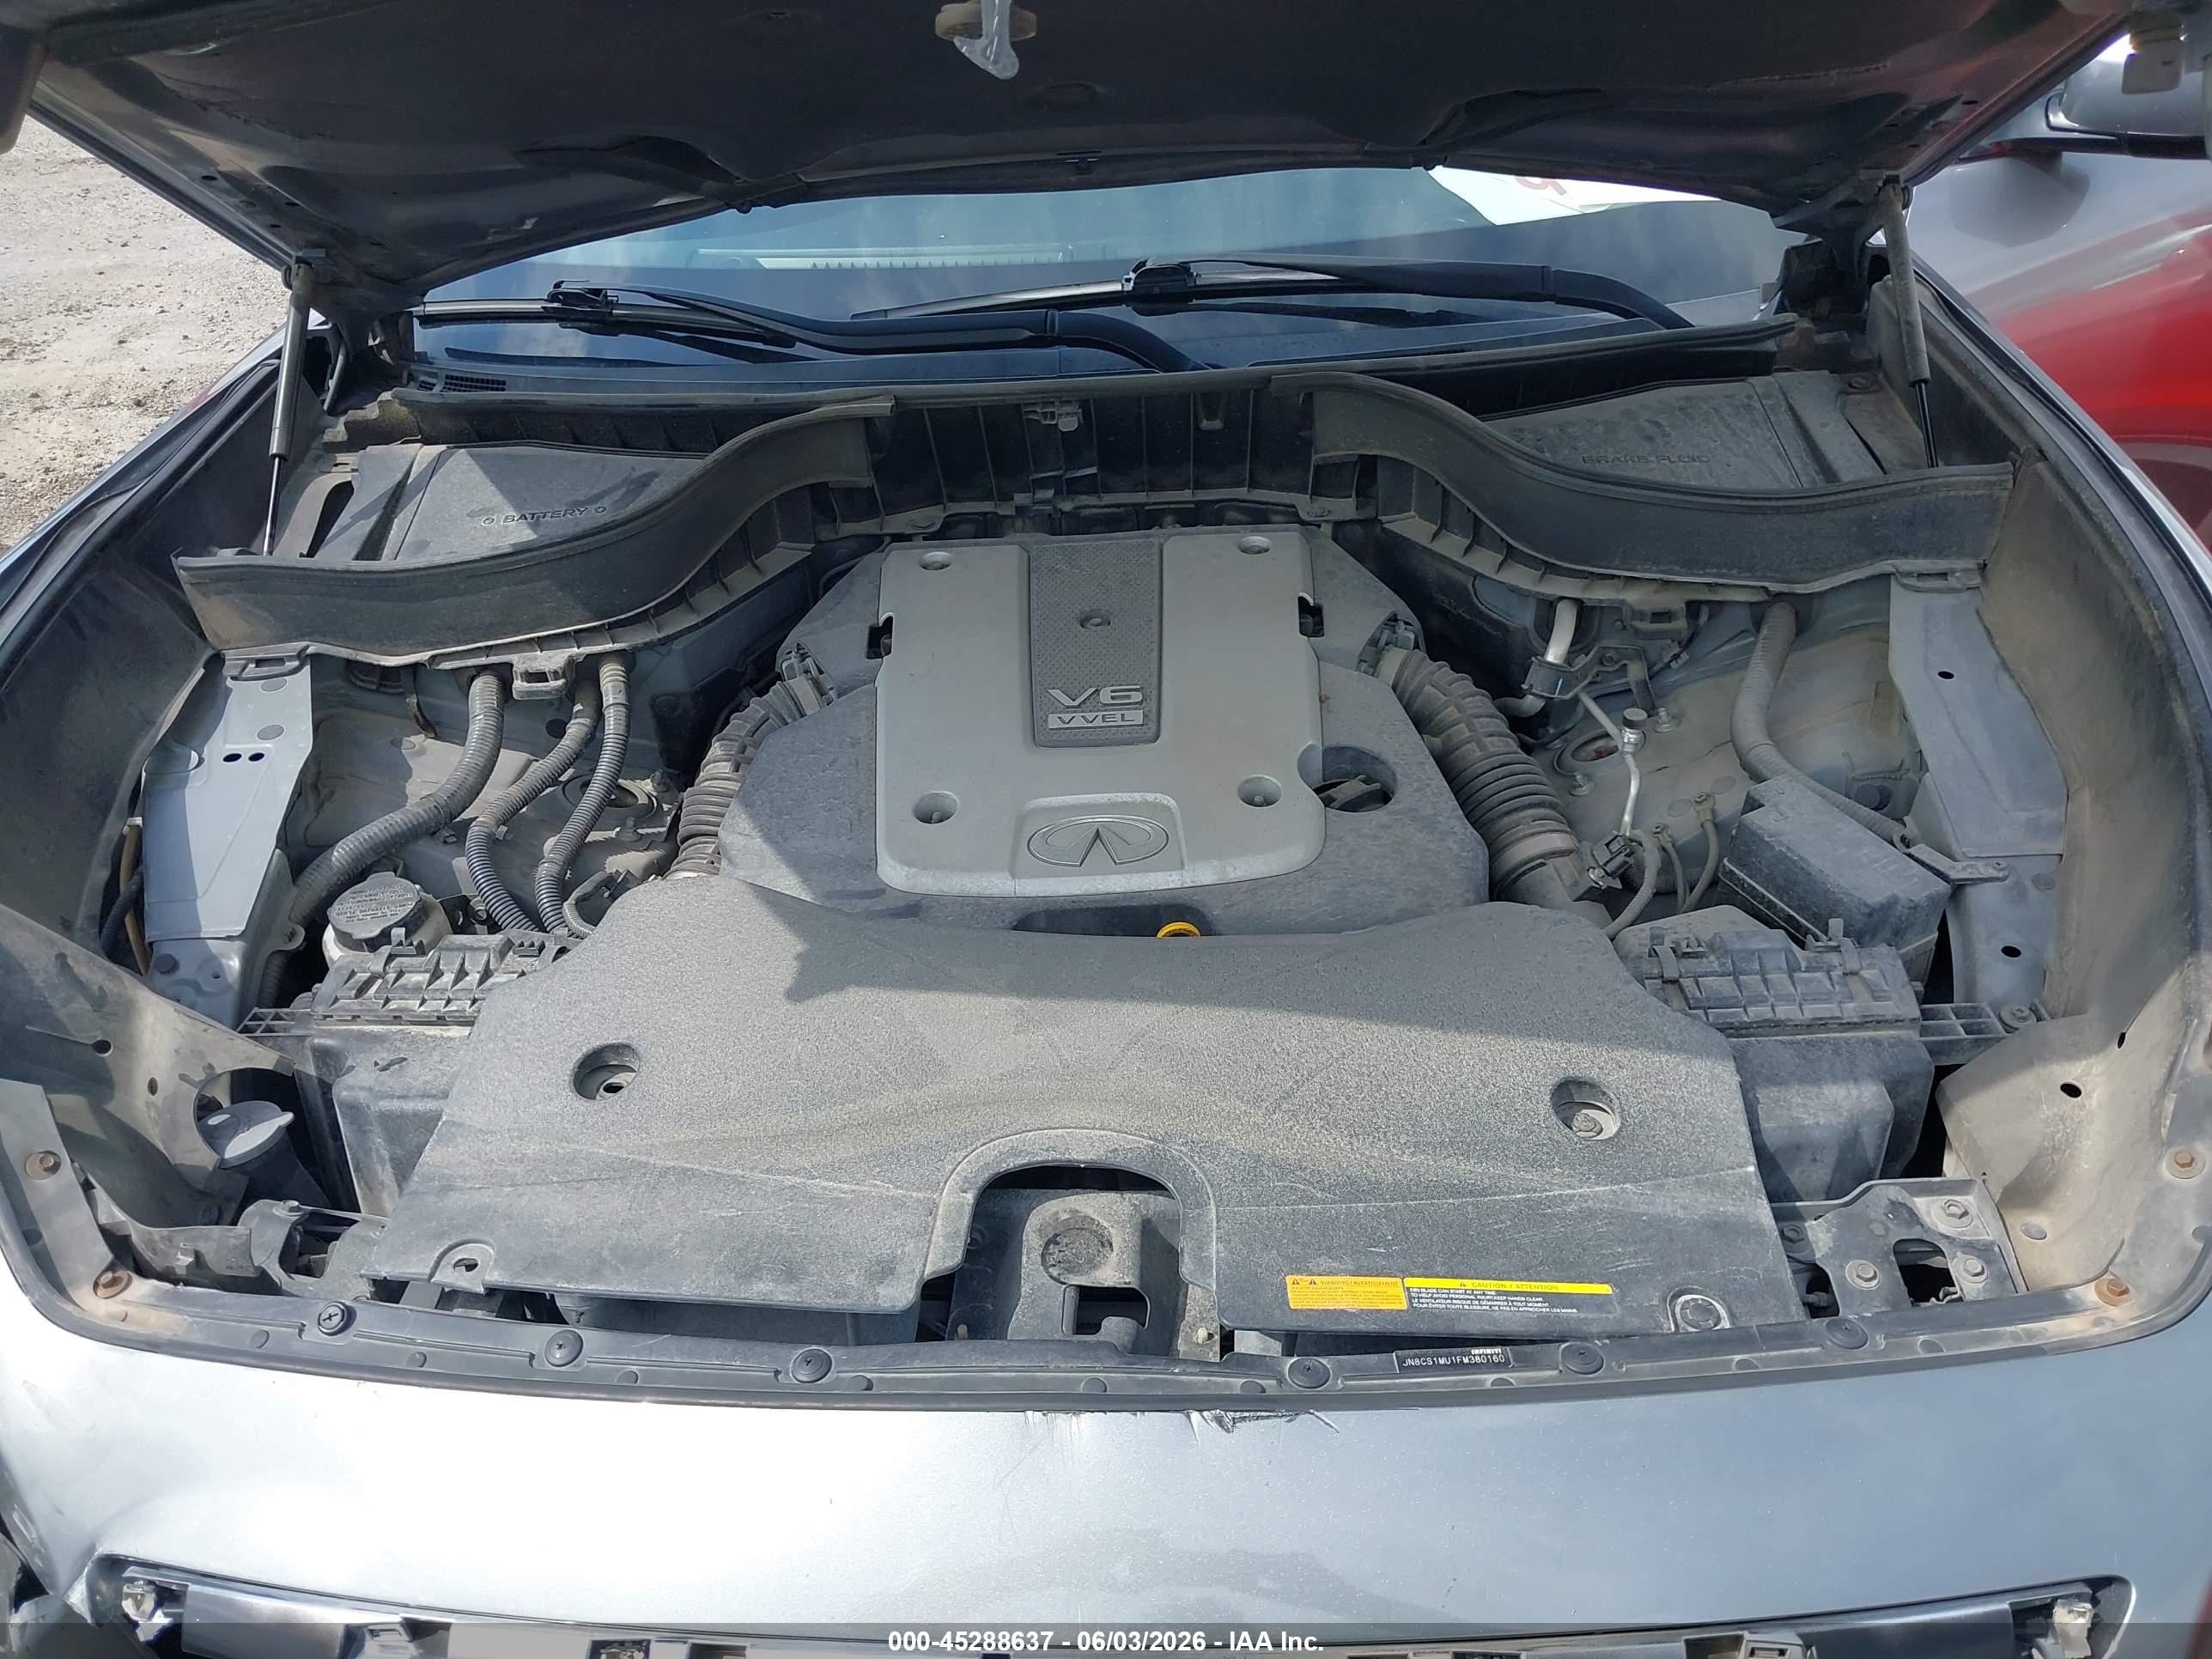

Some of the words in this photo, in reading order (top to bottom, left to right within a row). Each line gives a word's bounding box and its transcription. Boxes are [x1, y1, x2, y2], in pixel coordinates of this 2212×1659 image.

[1581, 454, 1650, 464] BRAKE
[1655, 454, 1711, 464] FLUID
[501, 507, 590, 524] BATTERY
[1047, 685, 1143, 708] V6
[1057, 713, 1135, 725] VVEL
[1402, 1354, 1505, 1367] JN8CS1MU1FM380160
